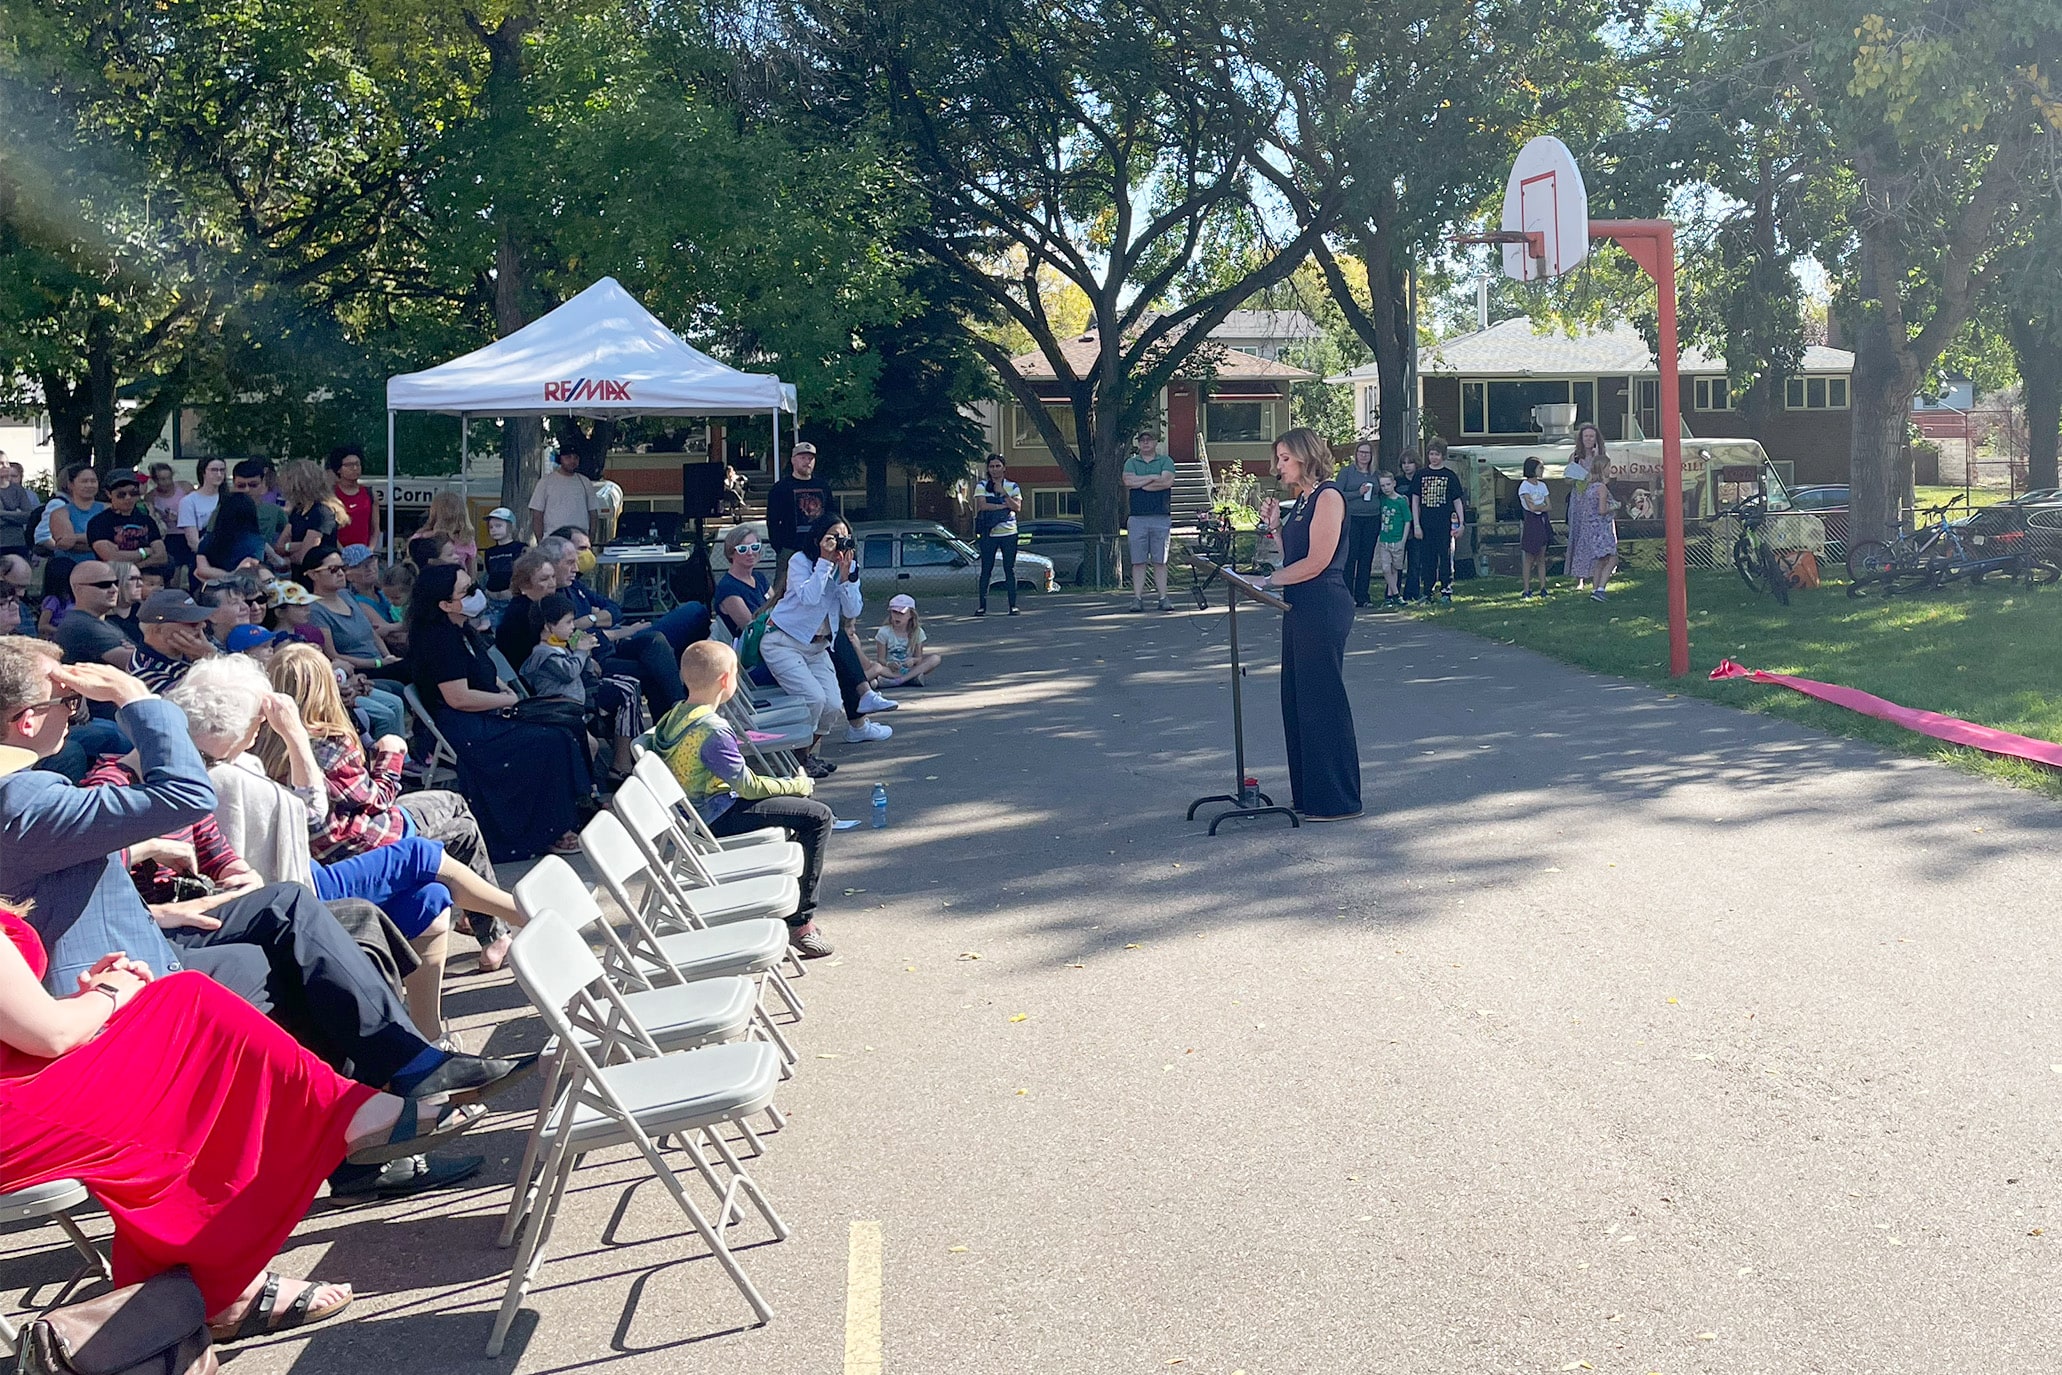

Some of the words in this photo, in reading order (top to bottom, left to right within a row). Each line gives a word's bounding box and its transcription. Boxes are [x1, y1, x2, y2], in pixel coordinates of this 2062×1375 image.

[544, 377, 632, 402] RE/MAX
[1610, 465, 1627, 474] ON
[1680, 462, 1705, 472] RILL
[393, 486, 438, 502] Corn
